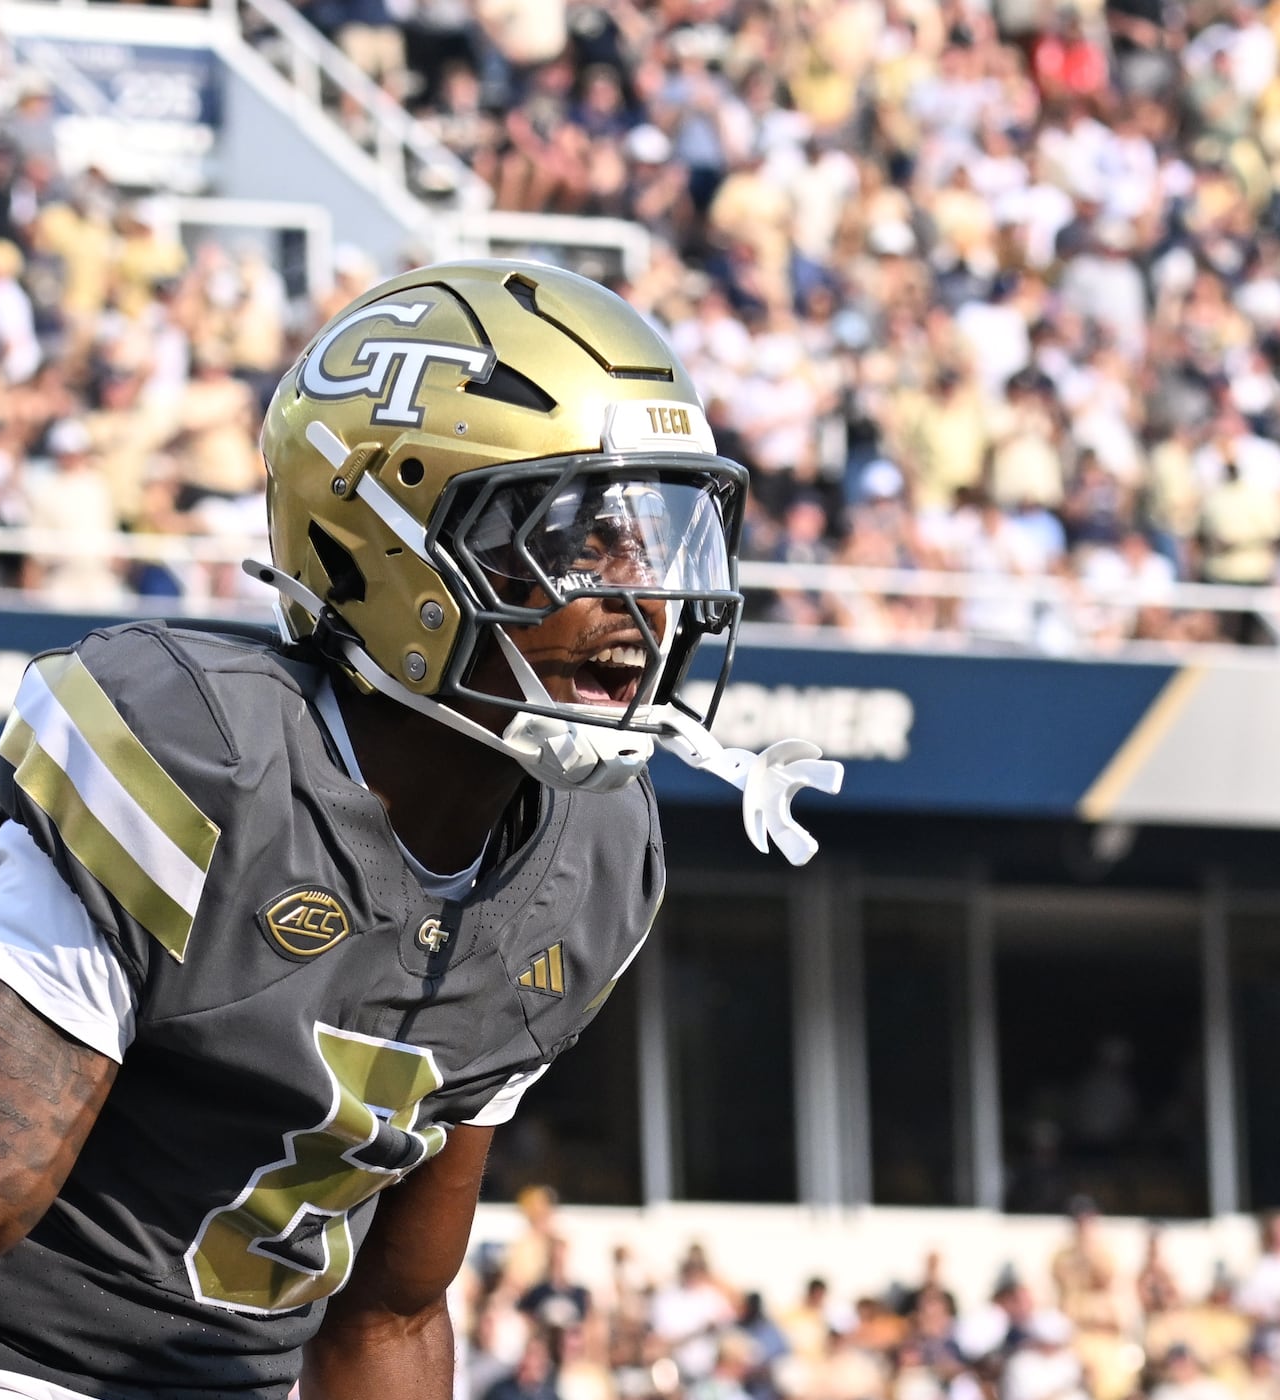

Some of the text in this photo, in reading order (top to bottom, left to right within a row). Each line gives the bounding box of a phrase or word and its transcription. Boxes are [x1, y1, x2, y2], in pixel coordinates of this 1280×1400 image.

[297, 299, 497, 427] GT
[646, 407, 692, 435] TECH
[278, 905, 341, 935] ACC
[419, 918, 449, 952] GT
